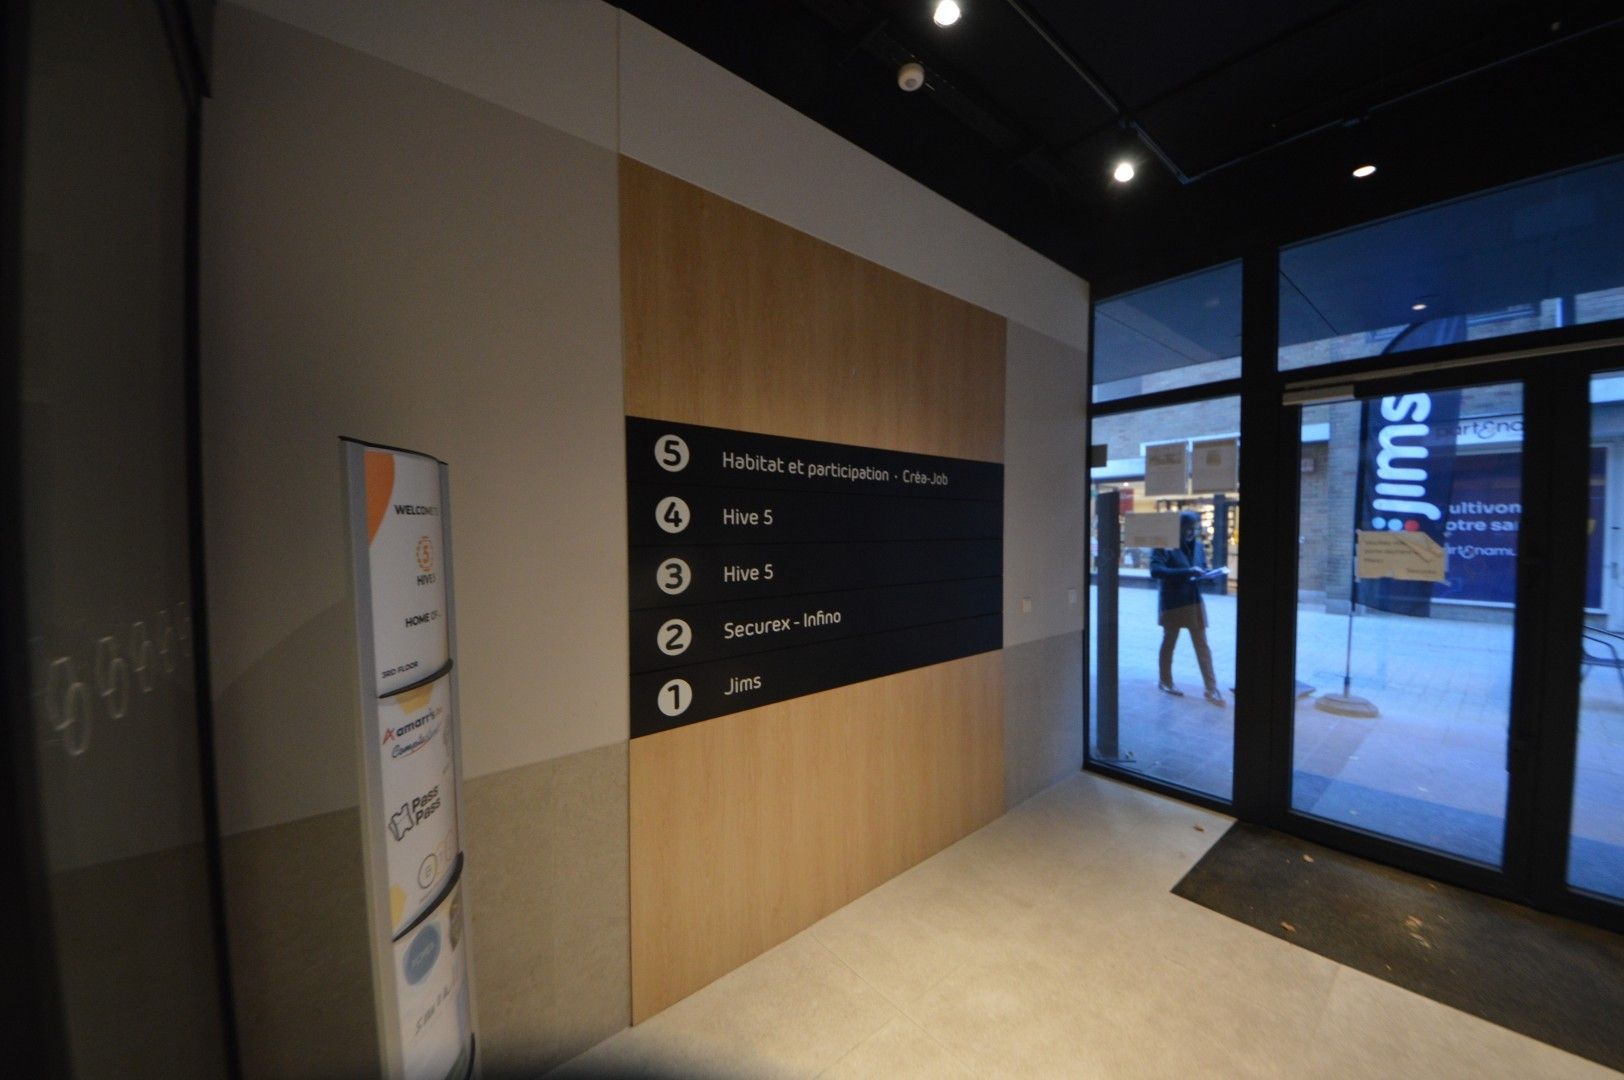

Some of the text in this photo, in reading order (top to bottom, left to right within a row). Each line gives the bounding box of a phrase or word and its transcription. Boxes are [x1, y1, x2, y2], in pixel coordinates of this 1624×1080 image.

[662, 439, 682, 467] 5
[722, 451, 785, 473] Habitat
[788, 459, 805, 475] et
[807, 463, 890, 483] participation
[902, 468, 949, 486] Créa-Job
[663, 502, 774, 528] 4 Hive 5
[1449, 501, 1522, 515] ultivon
[1446, 520, 1486, 532] otre
[664, 561, 774, 589] 3 Hive 5
[405, 611, 430, 627] HOME
[664, 622, 684, 650] 2
[724, 618, 791, 640] Securex
[803, 610, 842, 628] Infino
[665, 675, 762, 711] 1 Jims
[411, 785, 439, 812] Pass
[415, 798, 441, 825] Pass
